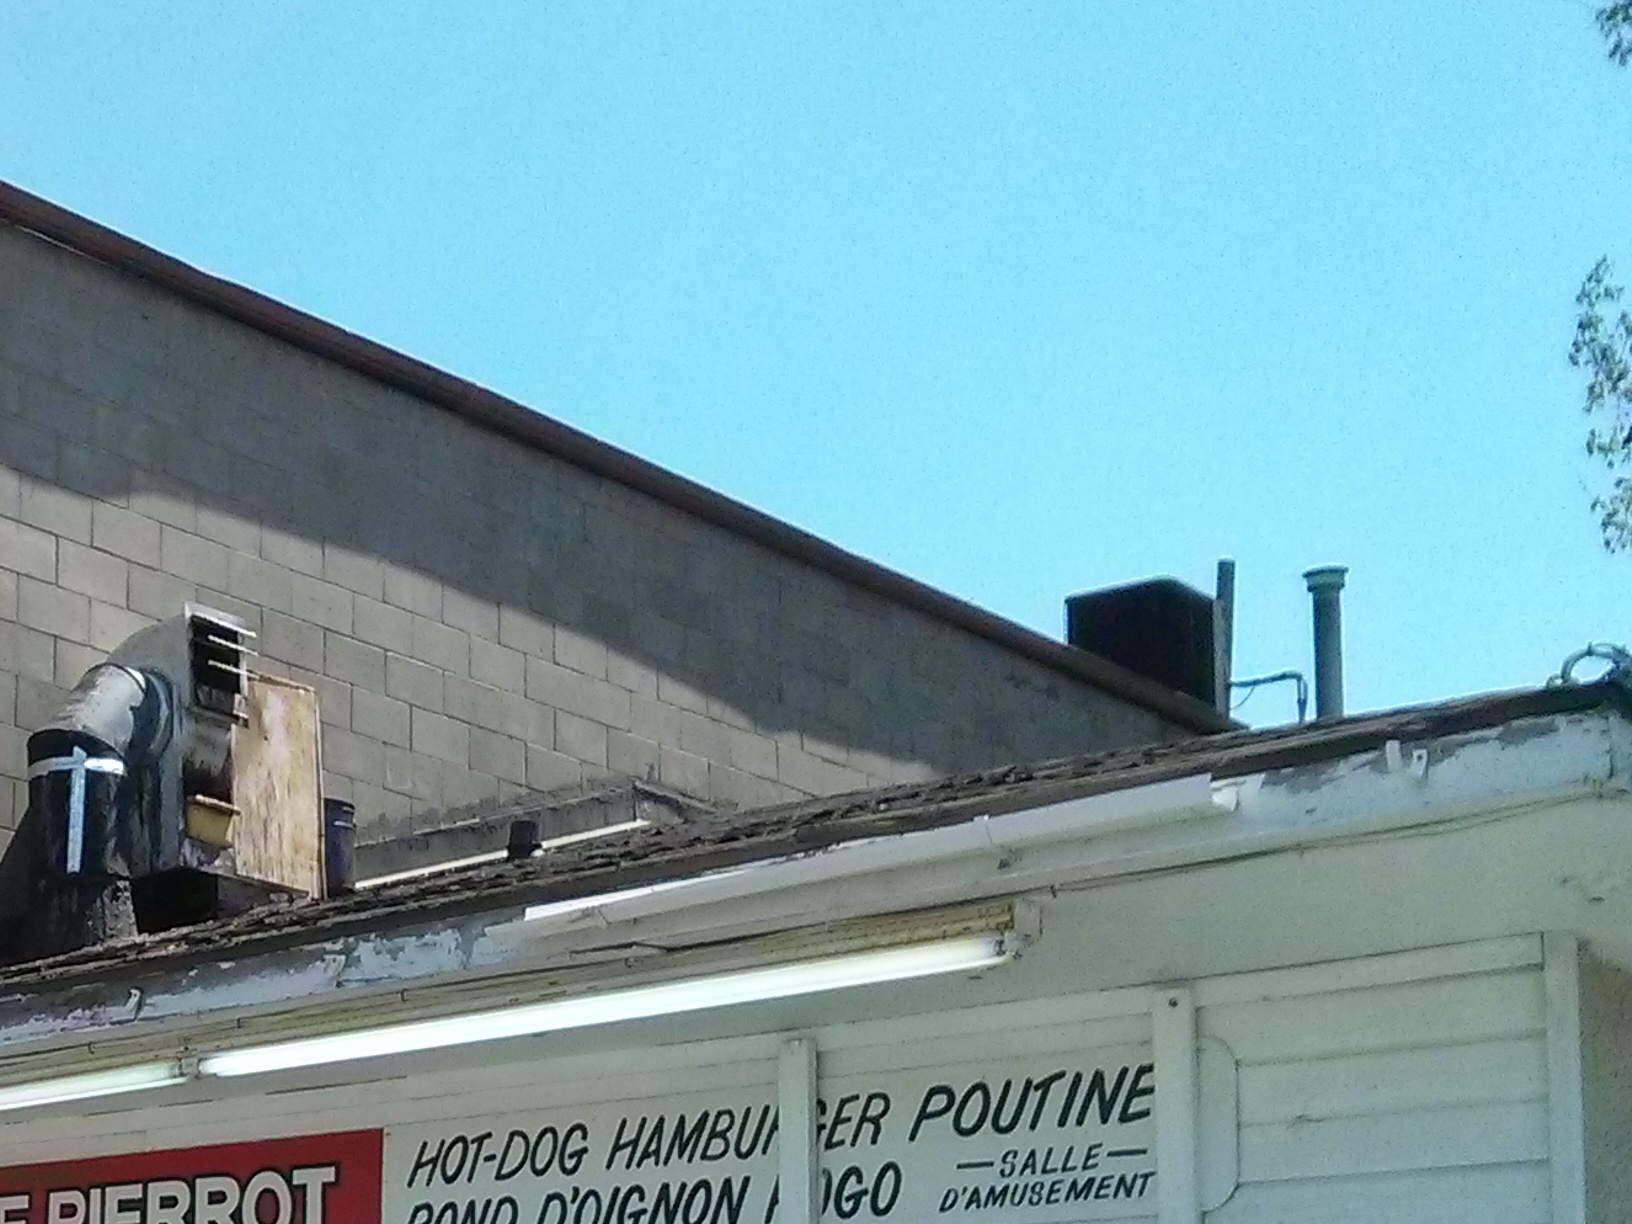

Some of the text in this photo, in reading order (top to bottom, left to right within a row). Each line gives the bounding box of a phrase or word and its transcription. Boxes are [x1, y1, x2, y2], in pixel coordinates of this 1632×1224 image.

[406, 1122, 590, 1187] HOT-DOG
[908, 1061, 1155, 1142] POUTINE
[999, 1142, 1104, 1179] SALLE
[938, 1171, 1157, 1214] D'AMUSEMENT
